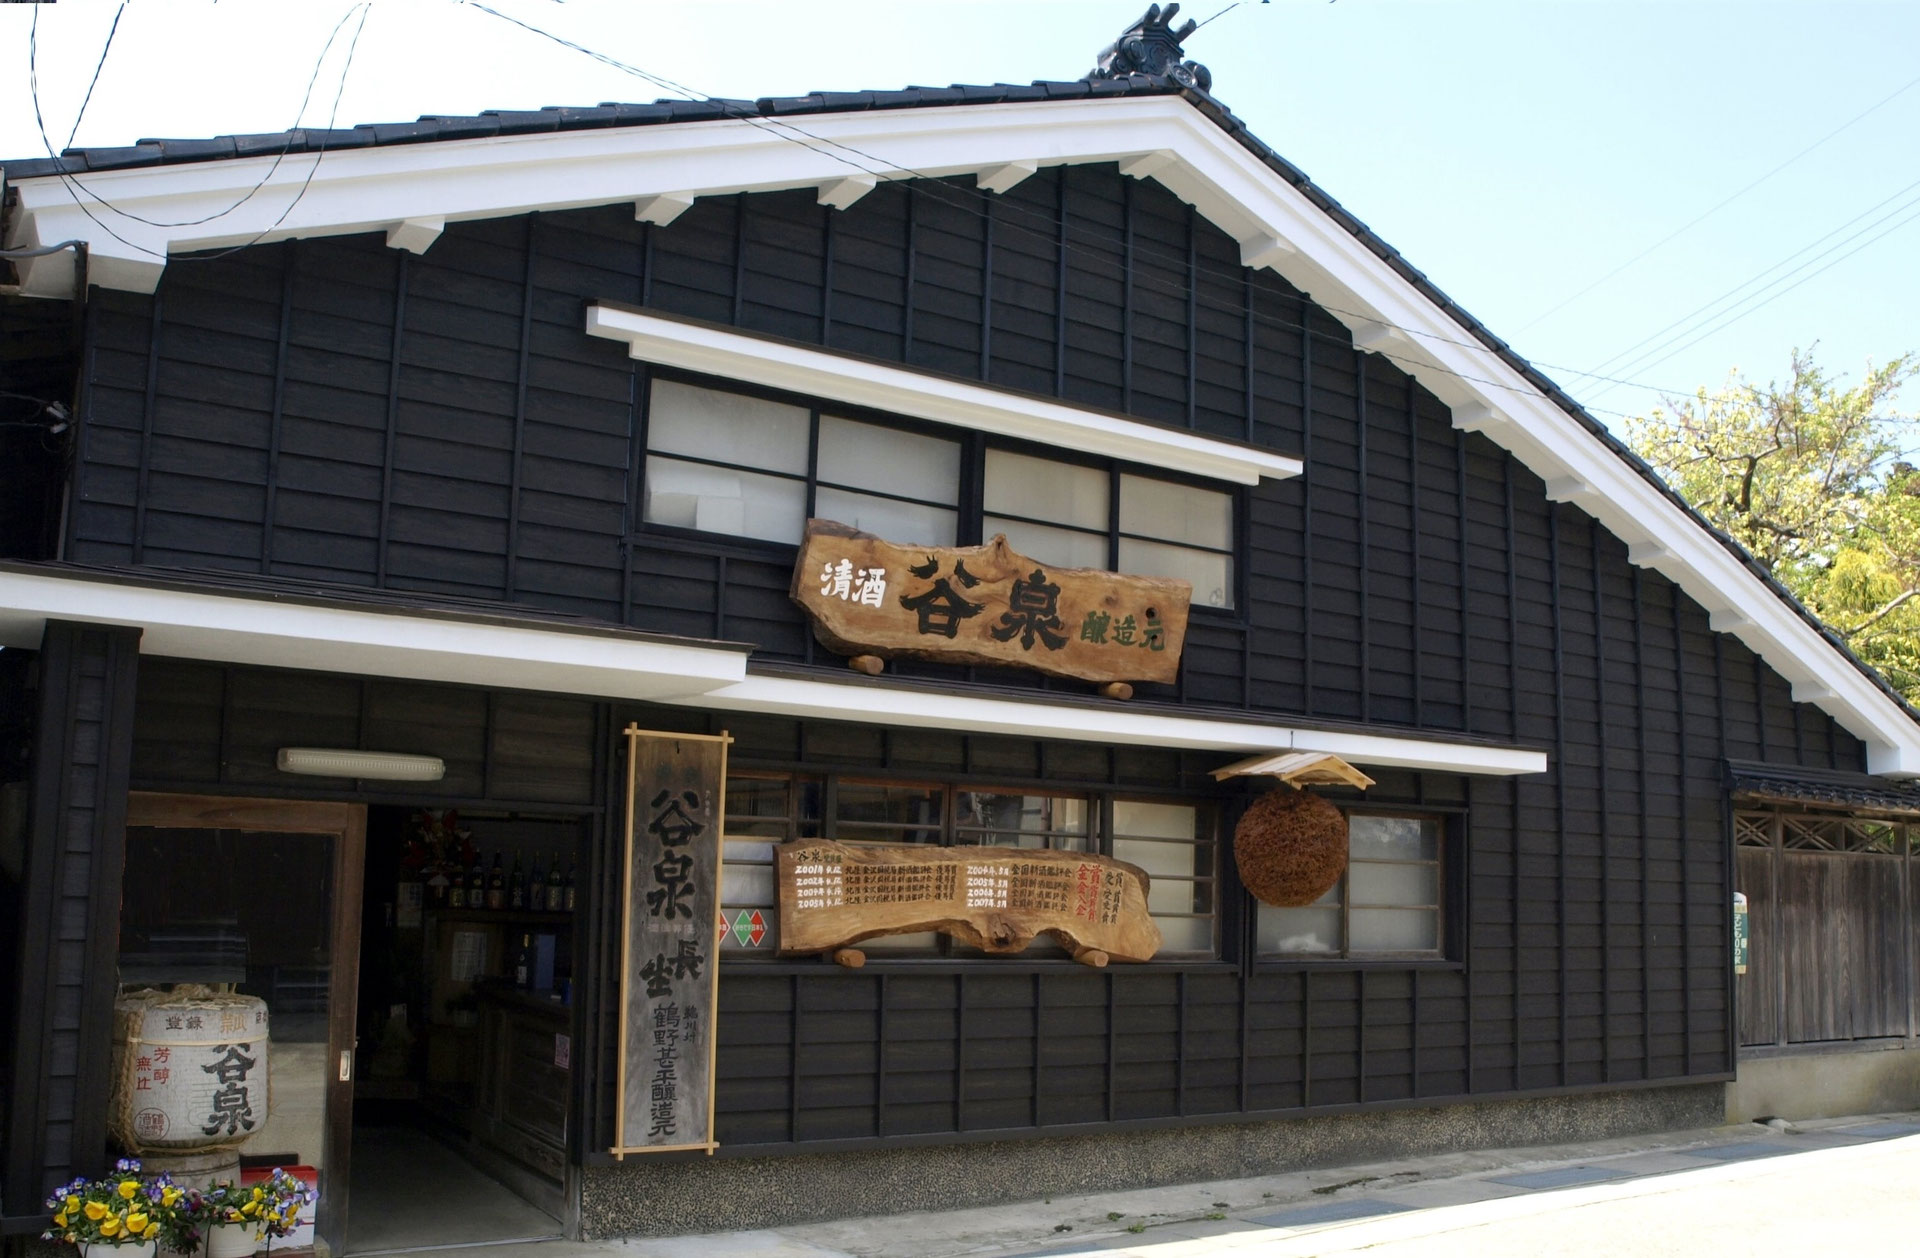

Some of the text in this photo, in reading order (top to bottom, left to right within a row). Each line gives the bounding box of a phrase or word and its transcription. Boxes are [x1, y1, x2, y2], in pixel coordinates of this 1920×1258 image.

[820, 558, 886, 608] 清酒
[900, 555, 1069, 651] 谷泉
[647, 789, 706, 921] 谷泉
[795, 865, 823, 874] 2001年
[797, 849, 823, 863] 谷泉
[1076, 863, 1103, 884] 金賞
[136, 1056, 151, 1090] 無比
[201, 1042, 256, 1136] 谷泉
